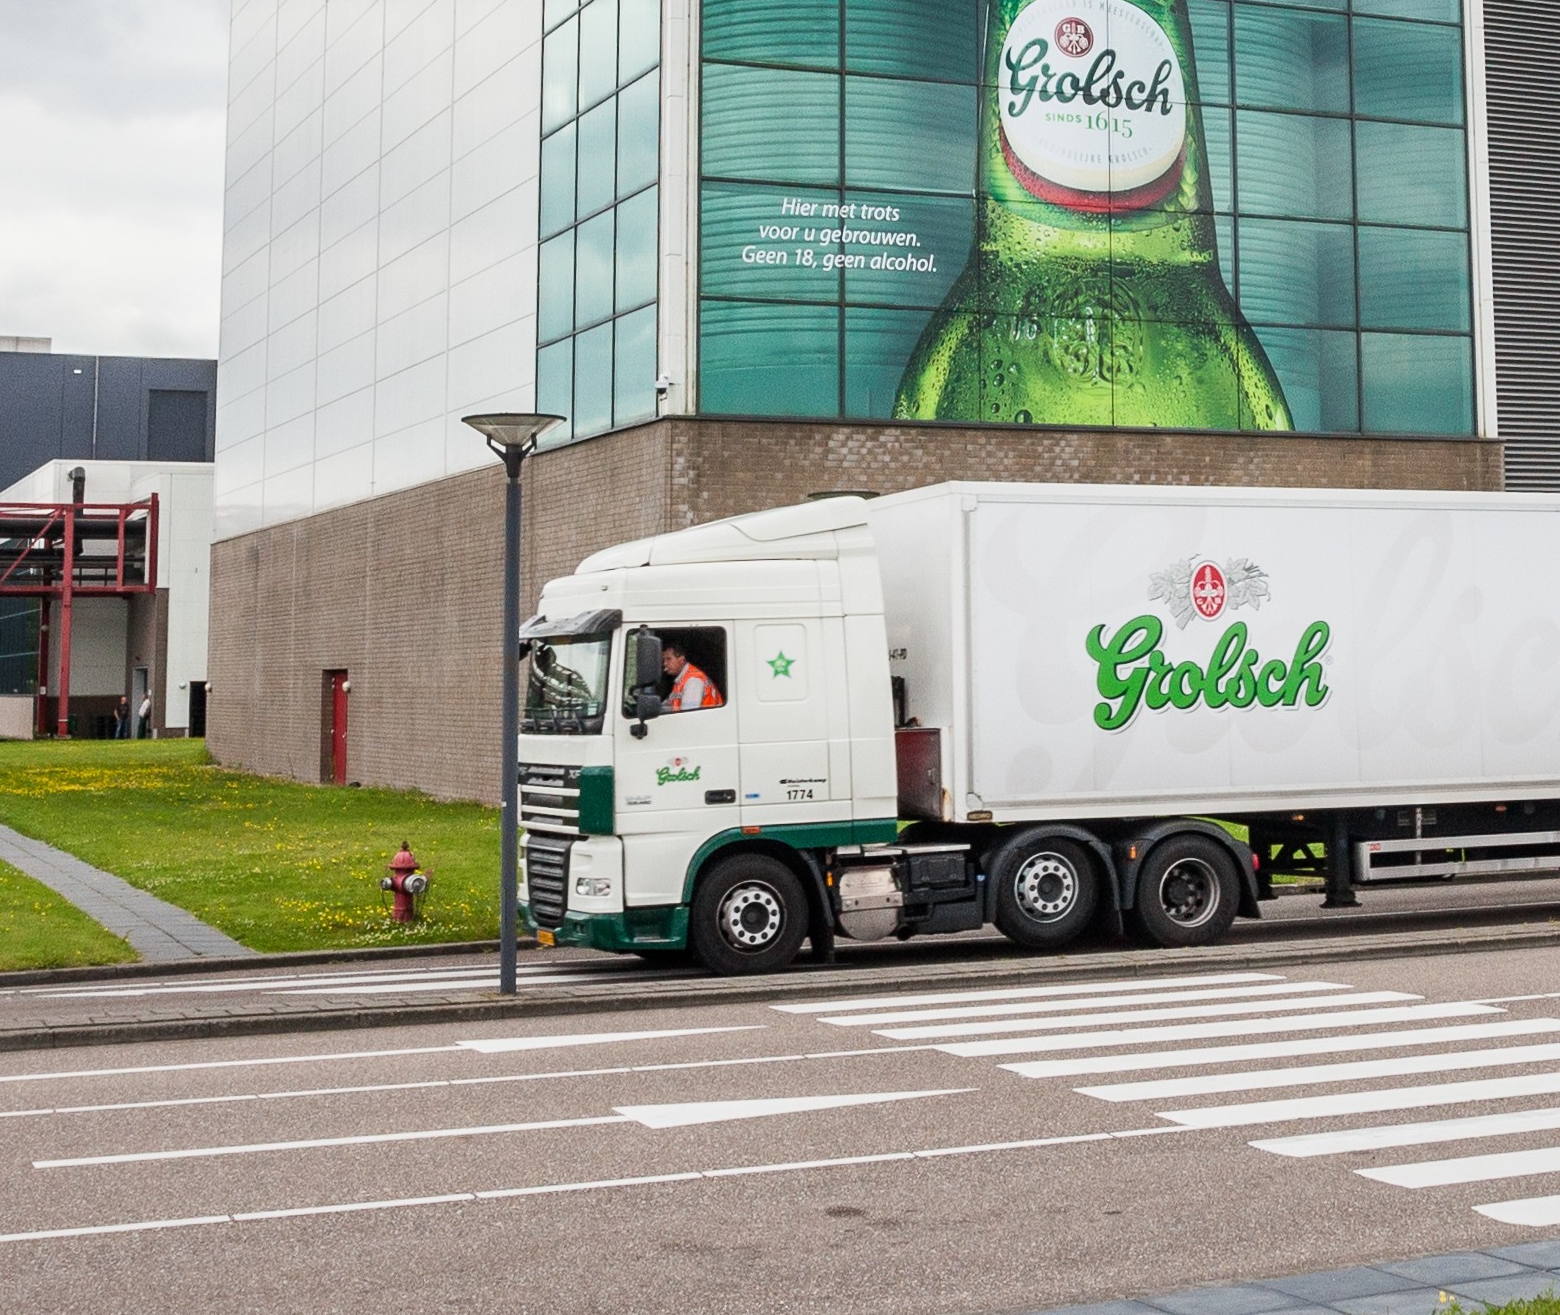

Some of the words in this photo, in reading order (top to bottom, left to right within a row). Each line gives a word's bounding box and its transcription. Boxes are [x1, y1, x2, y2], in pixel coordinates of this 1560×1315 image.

[1005, 37, 1173, 118] Grolsch
[1045, 113, 1082, 124] SINDS
[1085, 110, 1133, 139] 1615
[781, 197, 818, 217] Hier
[822, 203, 856, 219] met
[860, 204, 900, 222] trots
[759, 224, 799, 240] voor
[804, 227, 815, 241] u
[819, 225, 921, 247] gebrouwen.
[742, 245, 787, 265] Geen
[794, 248, 817, 269] 18,
[822, 252, 865, 272] geen
[870, 252, 938, 273] alcohol.
[1086, 614, 1332, 732] Grolsch
[787, 789, 813, 800] 1774
